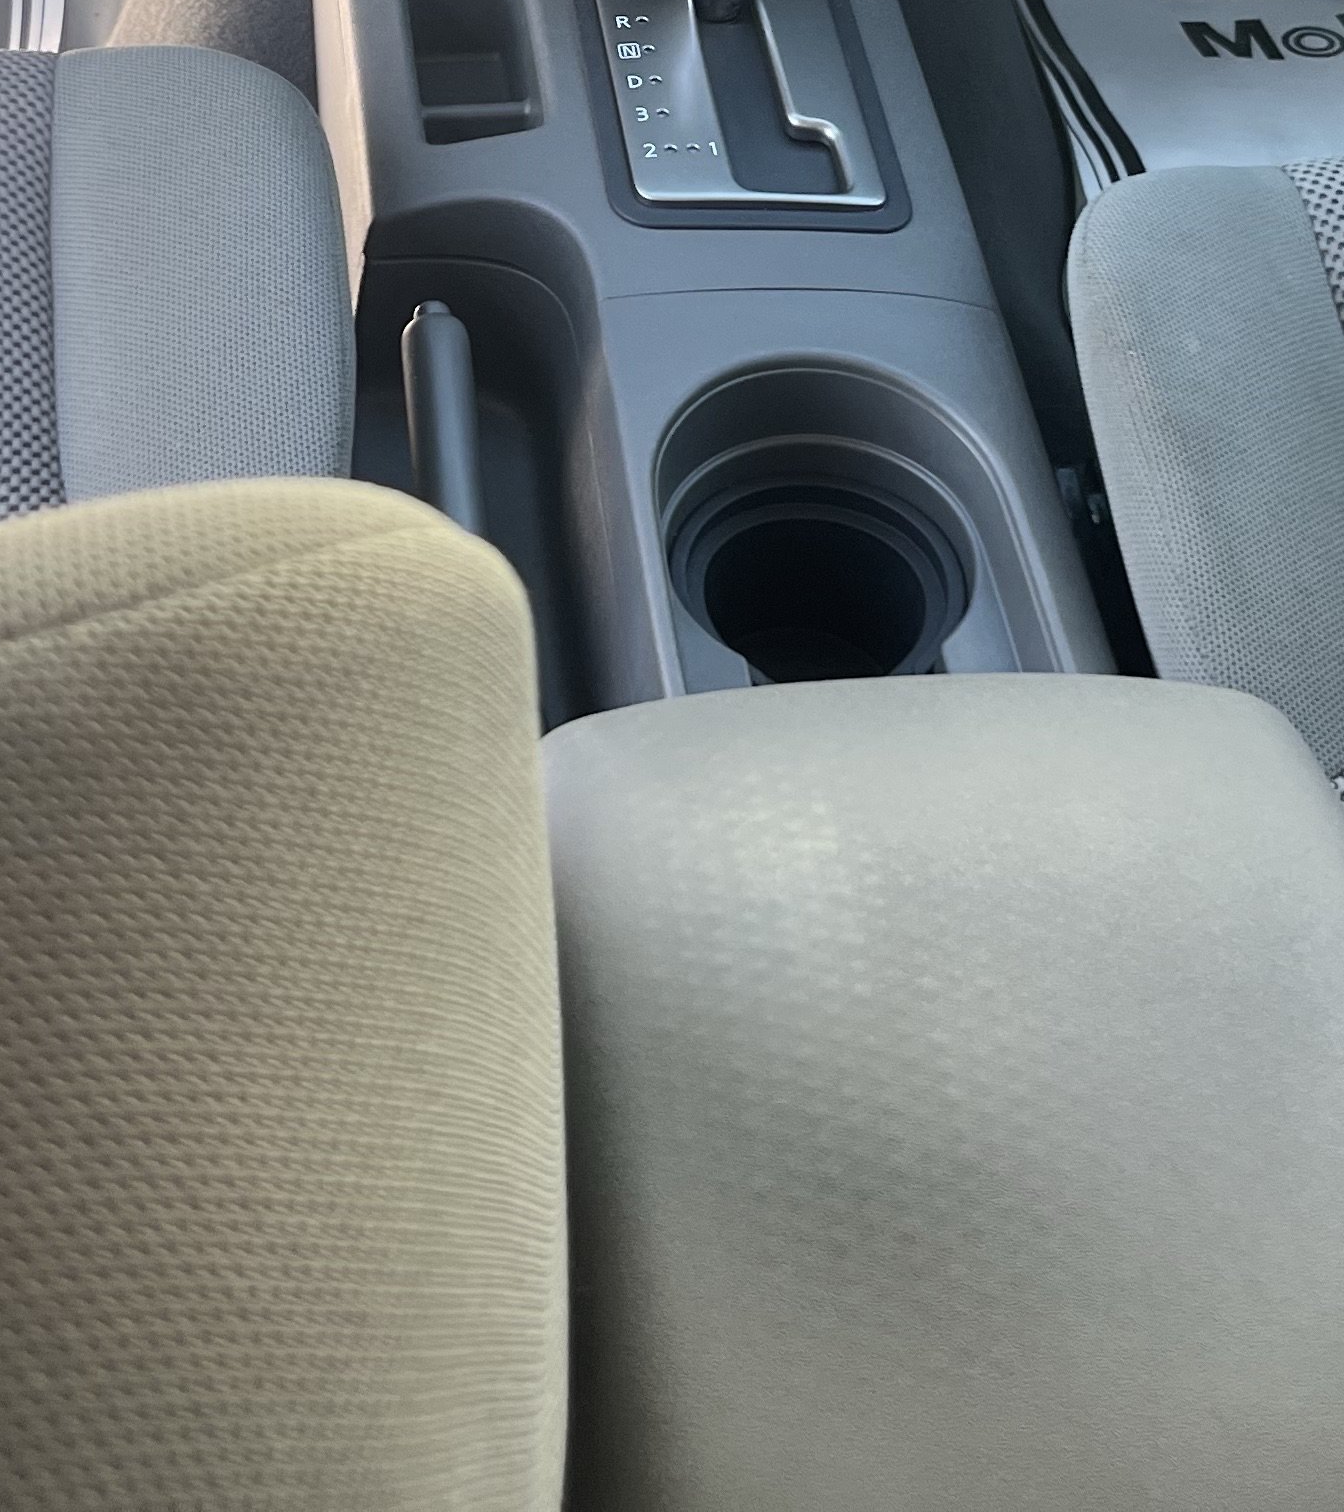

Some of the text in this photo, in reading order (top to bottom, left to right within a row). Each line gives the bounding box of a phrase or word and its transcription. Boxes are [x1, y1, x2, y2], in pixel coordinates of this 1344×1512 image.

[616, 16, 631, 28] R
[627, 75, 643, 88] D
[635, 107, 649, 121] 3
[643, 142, 718, 158] 2 1
